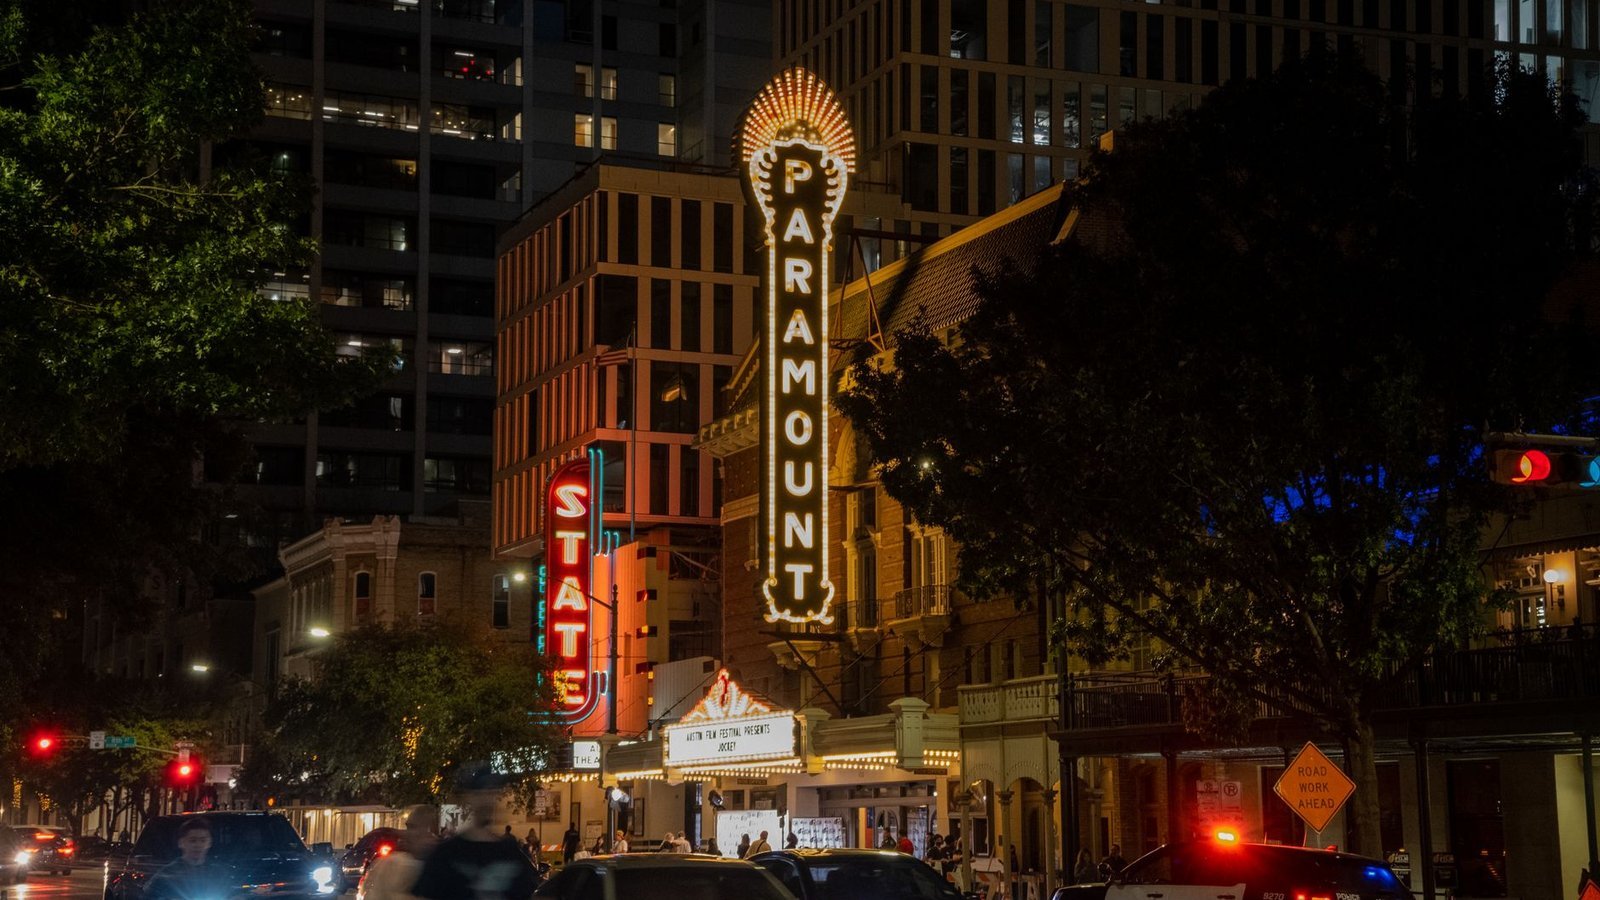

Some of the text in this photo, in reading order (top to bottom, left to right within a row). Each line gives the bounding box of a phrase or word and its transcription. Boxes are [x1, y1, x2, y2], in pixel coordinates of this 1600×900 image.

[782, 158, 816, 600] PARAMOUNT
[553, 484, 588, 704] STATE
[686, 723, 770, 742] AUSTIN FILM FESTIVAL PRESENTS
[717, 742, 736, 752] JOCKEY
[1298, 766, 1327, 777] ROAD
[1299, 782, 1330, 793] WORK
[1298, 798, 1335, 809] AHEAD
